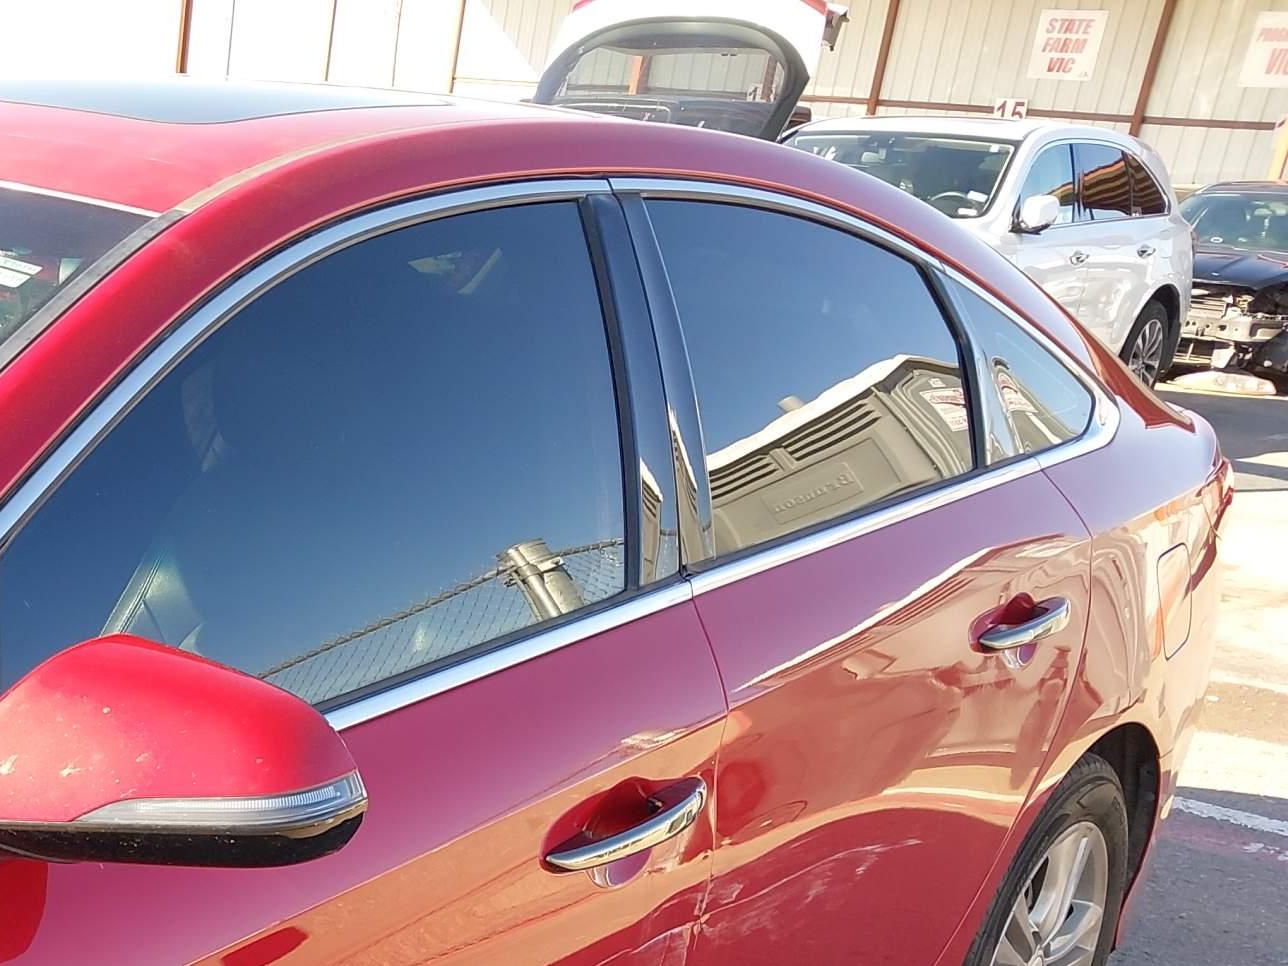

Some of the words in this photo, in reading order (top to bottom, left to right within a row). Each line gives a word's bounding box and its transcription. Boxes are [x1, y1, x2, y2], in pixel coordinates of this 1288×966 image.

[1046, 18, 1096, 34] STATE
[1041, 37, 1089, 54] FARM
[1046, 57, 1077, 74] VIC
[996, 100, 1026, 119] 15
